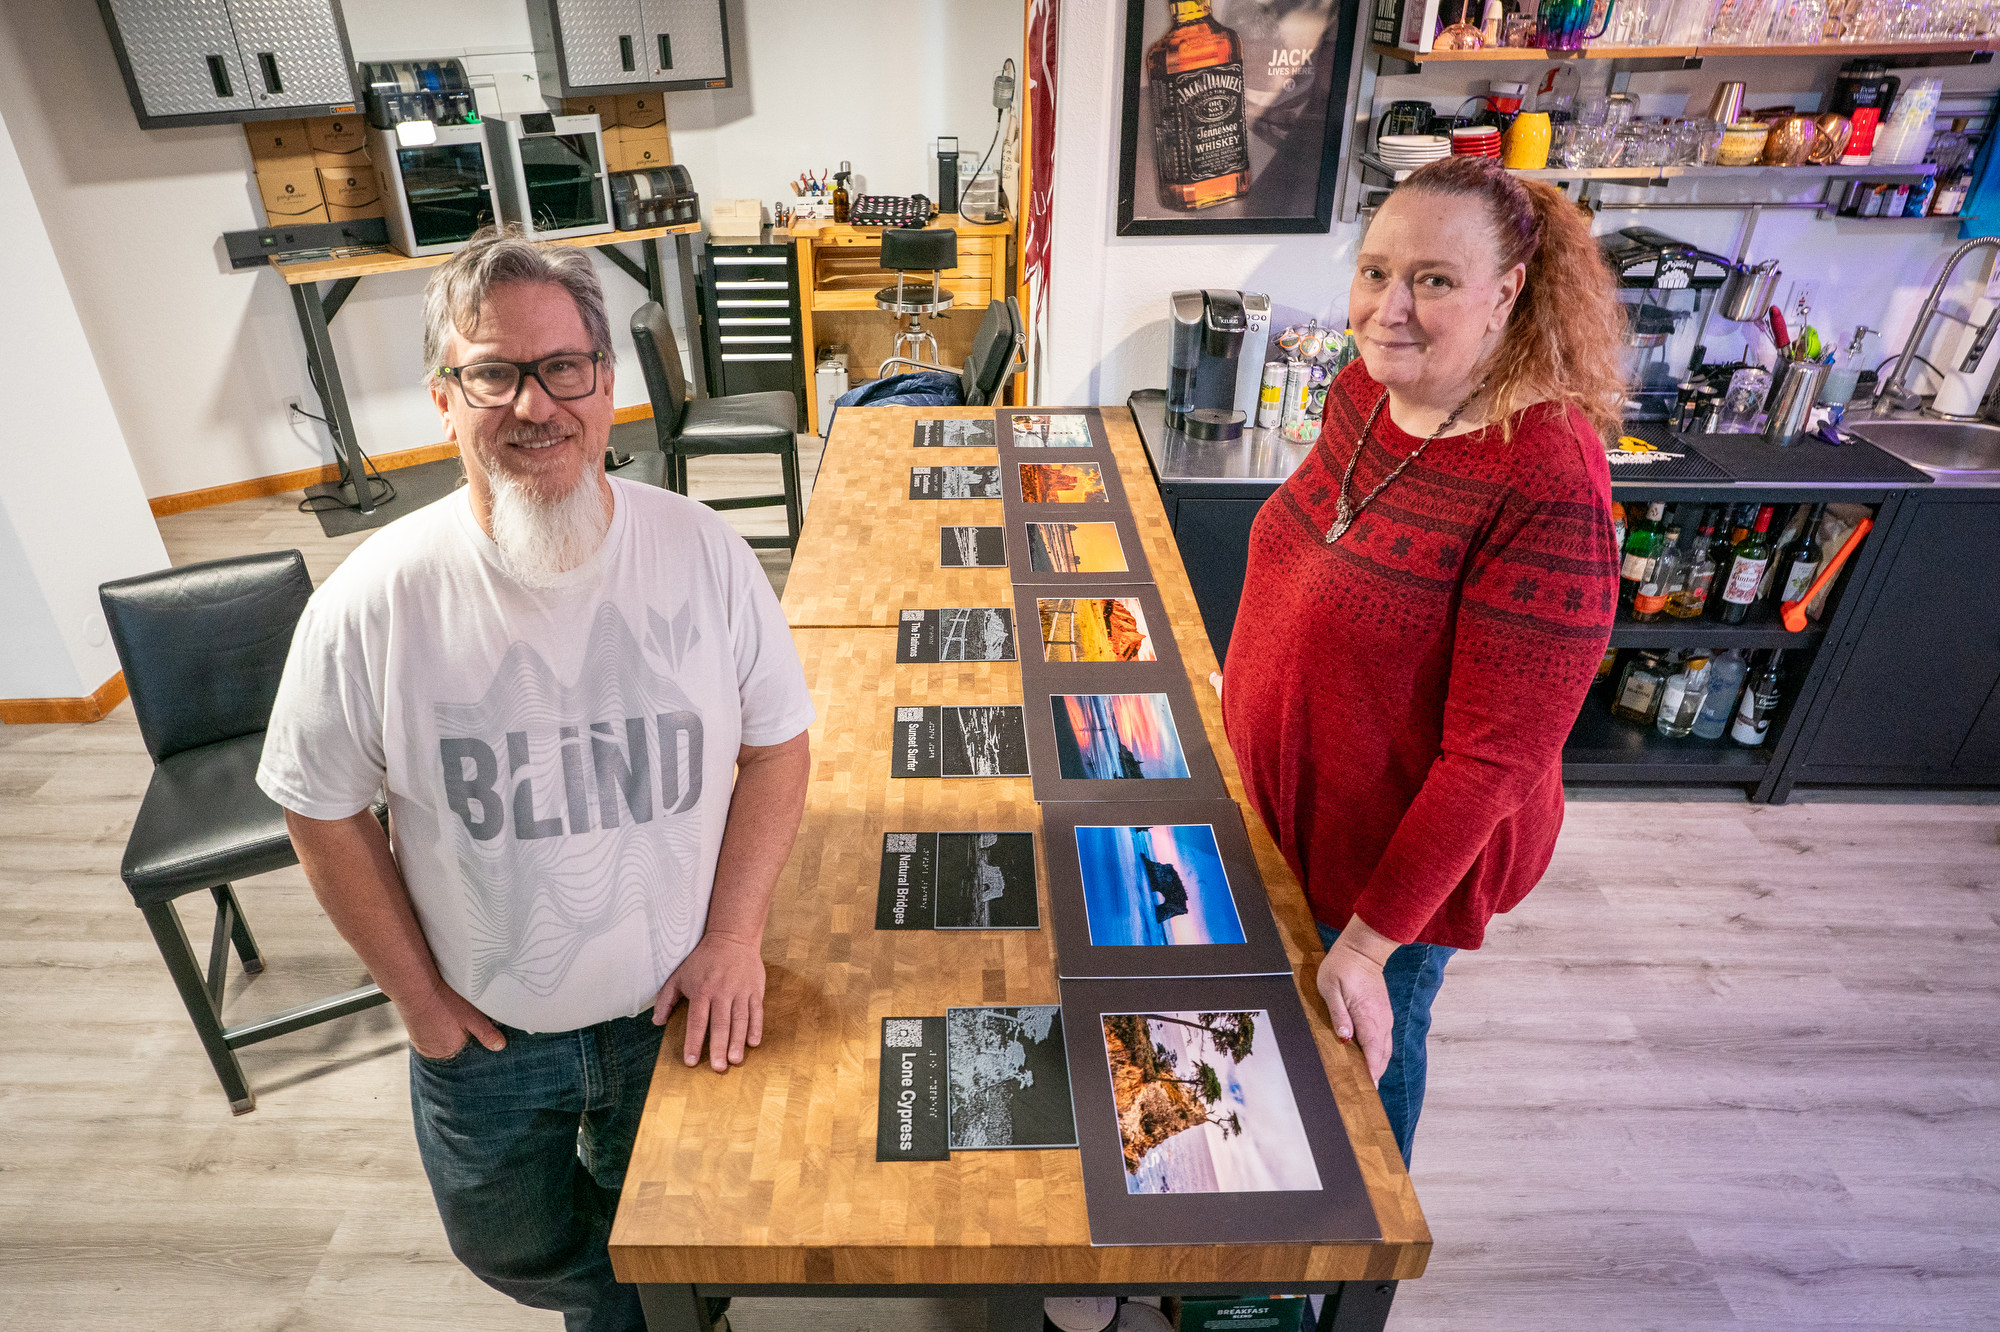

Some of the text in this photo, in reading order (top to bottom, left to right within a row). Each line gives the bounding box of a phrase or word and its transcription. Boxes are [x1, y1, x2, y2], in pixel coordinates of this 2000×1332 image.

[1268, 49, 1313, 67] JACK
[1268, 67, 1290, 76] LIVES
[1177, 80, 1204, 105] JACK
[1196, 122, 1238, 140] Tennessee
[1195, 135, 1240, 154] WHISKEY
[1662, 260, 1695, 272] Popcorn
[909, 622, 921, 658] The Flatirons
[906, 723, 920, 772] Sunset Surfer
[893, 854, 911, 925] Natural Bridges
[896, 1052, 917, 1151] Lone Cypress
[1217, 1308, 1270, 1316] BREAKFAST
